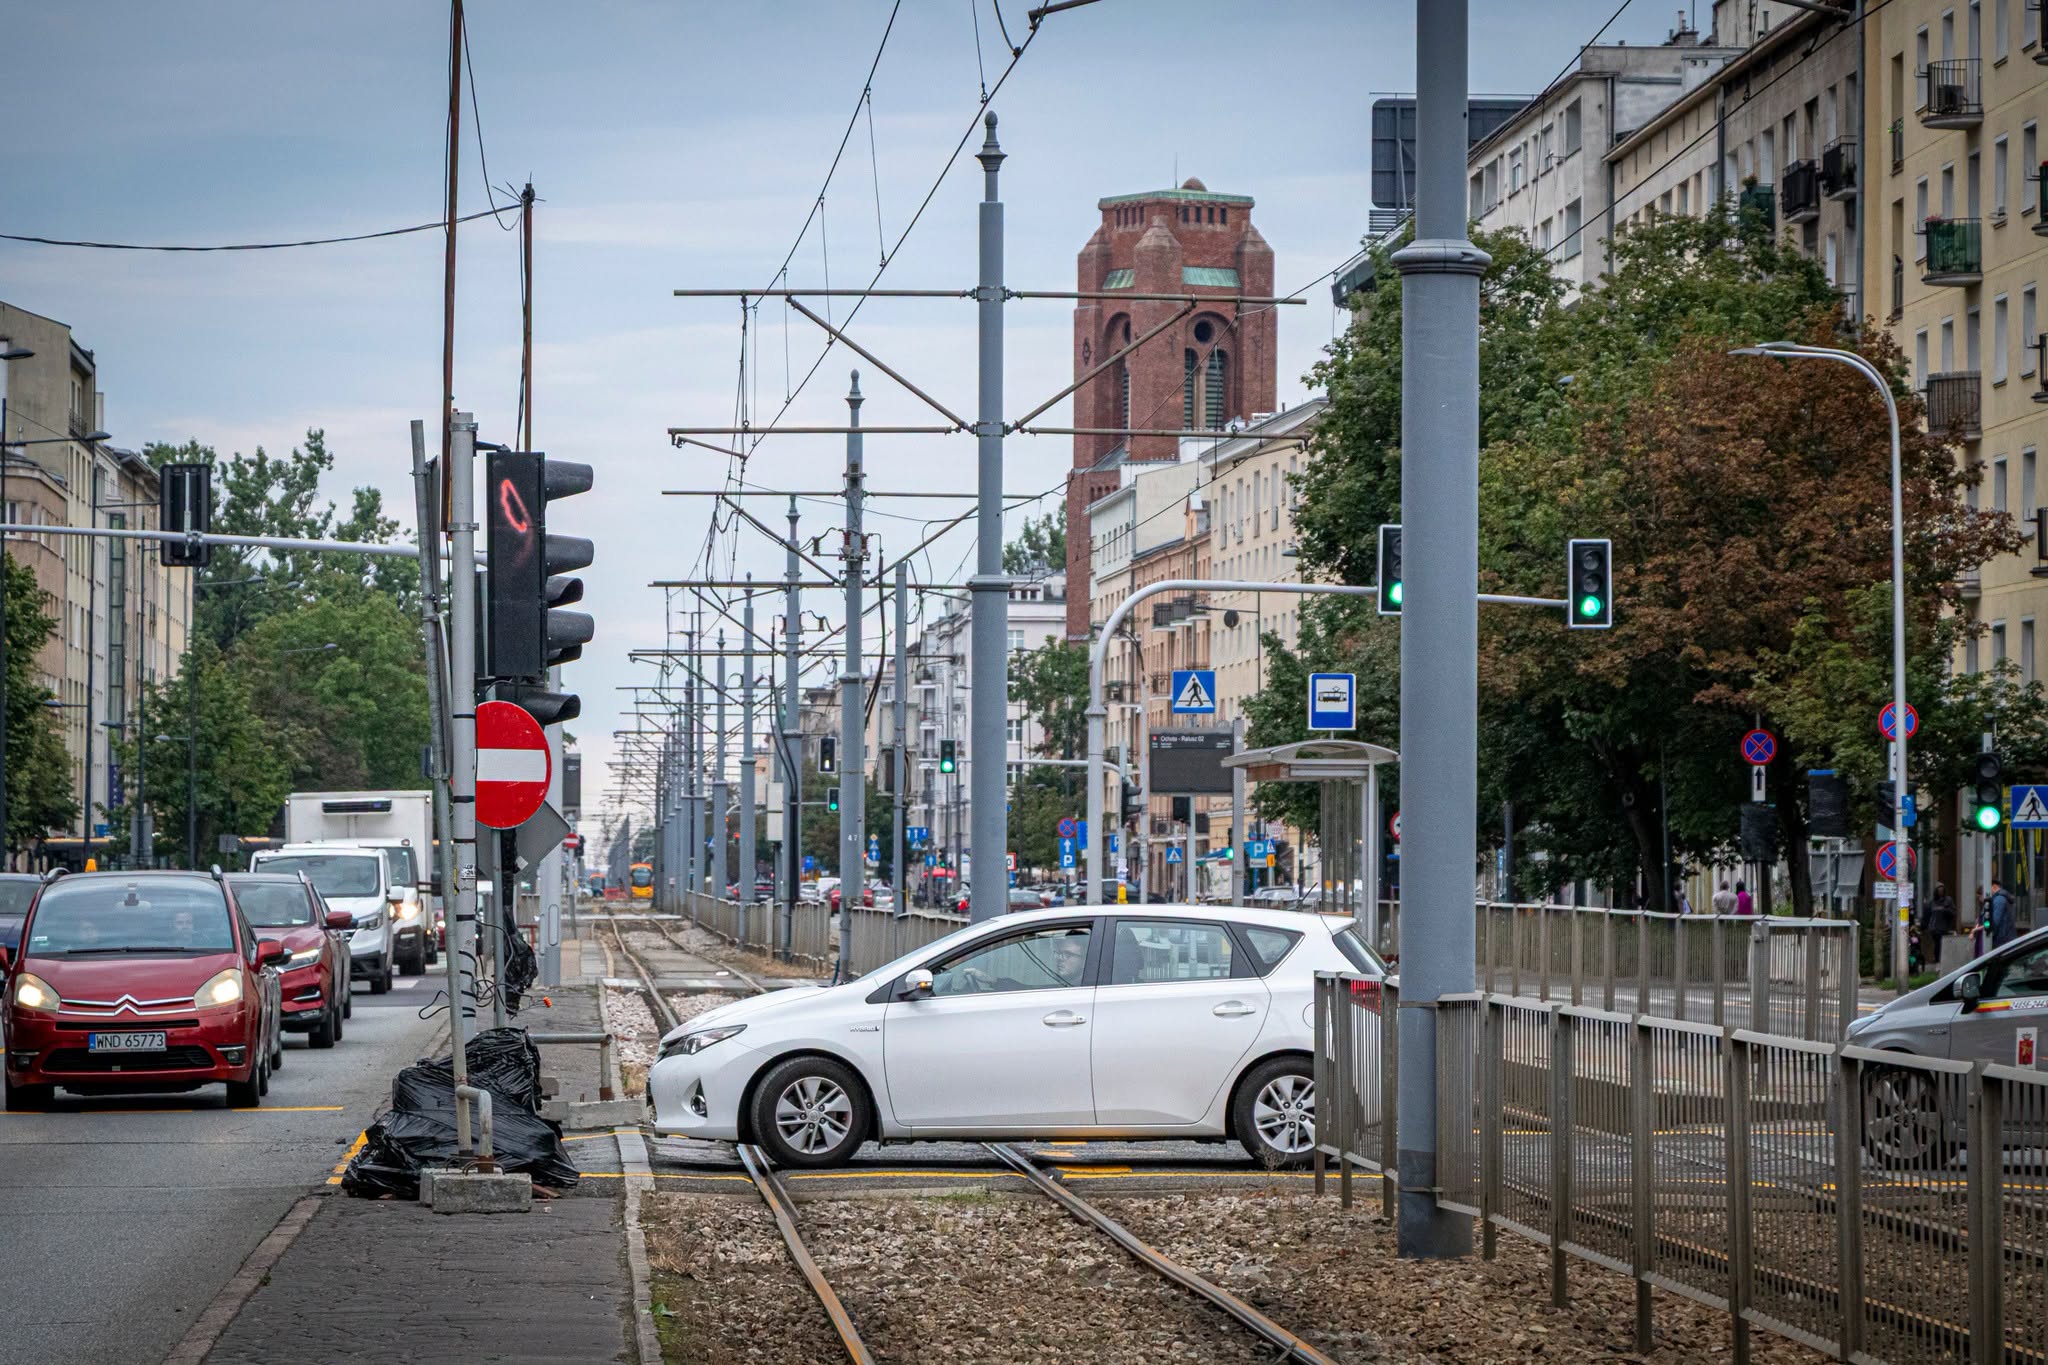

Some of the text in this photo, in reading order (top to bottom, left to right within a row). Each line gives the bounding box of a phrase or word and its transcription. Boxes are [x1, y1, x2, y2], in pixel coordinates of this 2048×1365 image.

[1254, 843, 1264, 857] P
[1063, 855, 1073, 867] P
[96, 1034, 164, 1048] WND 65773
